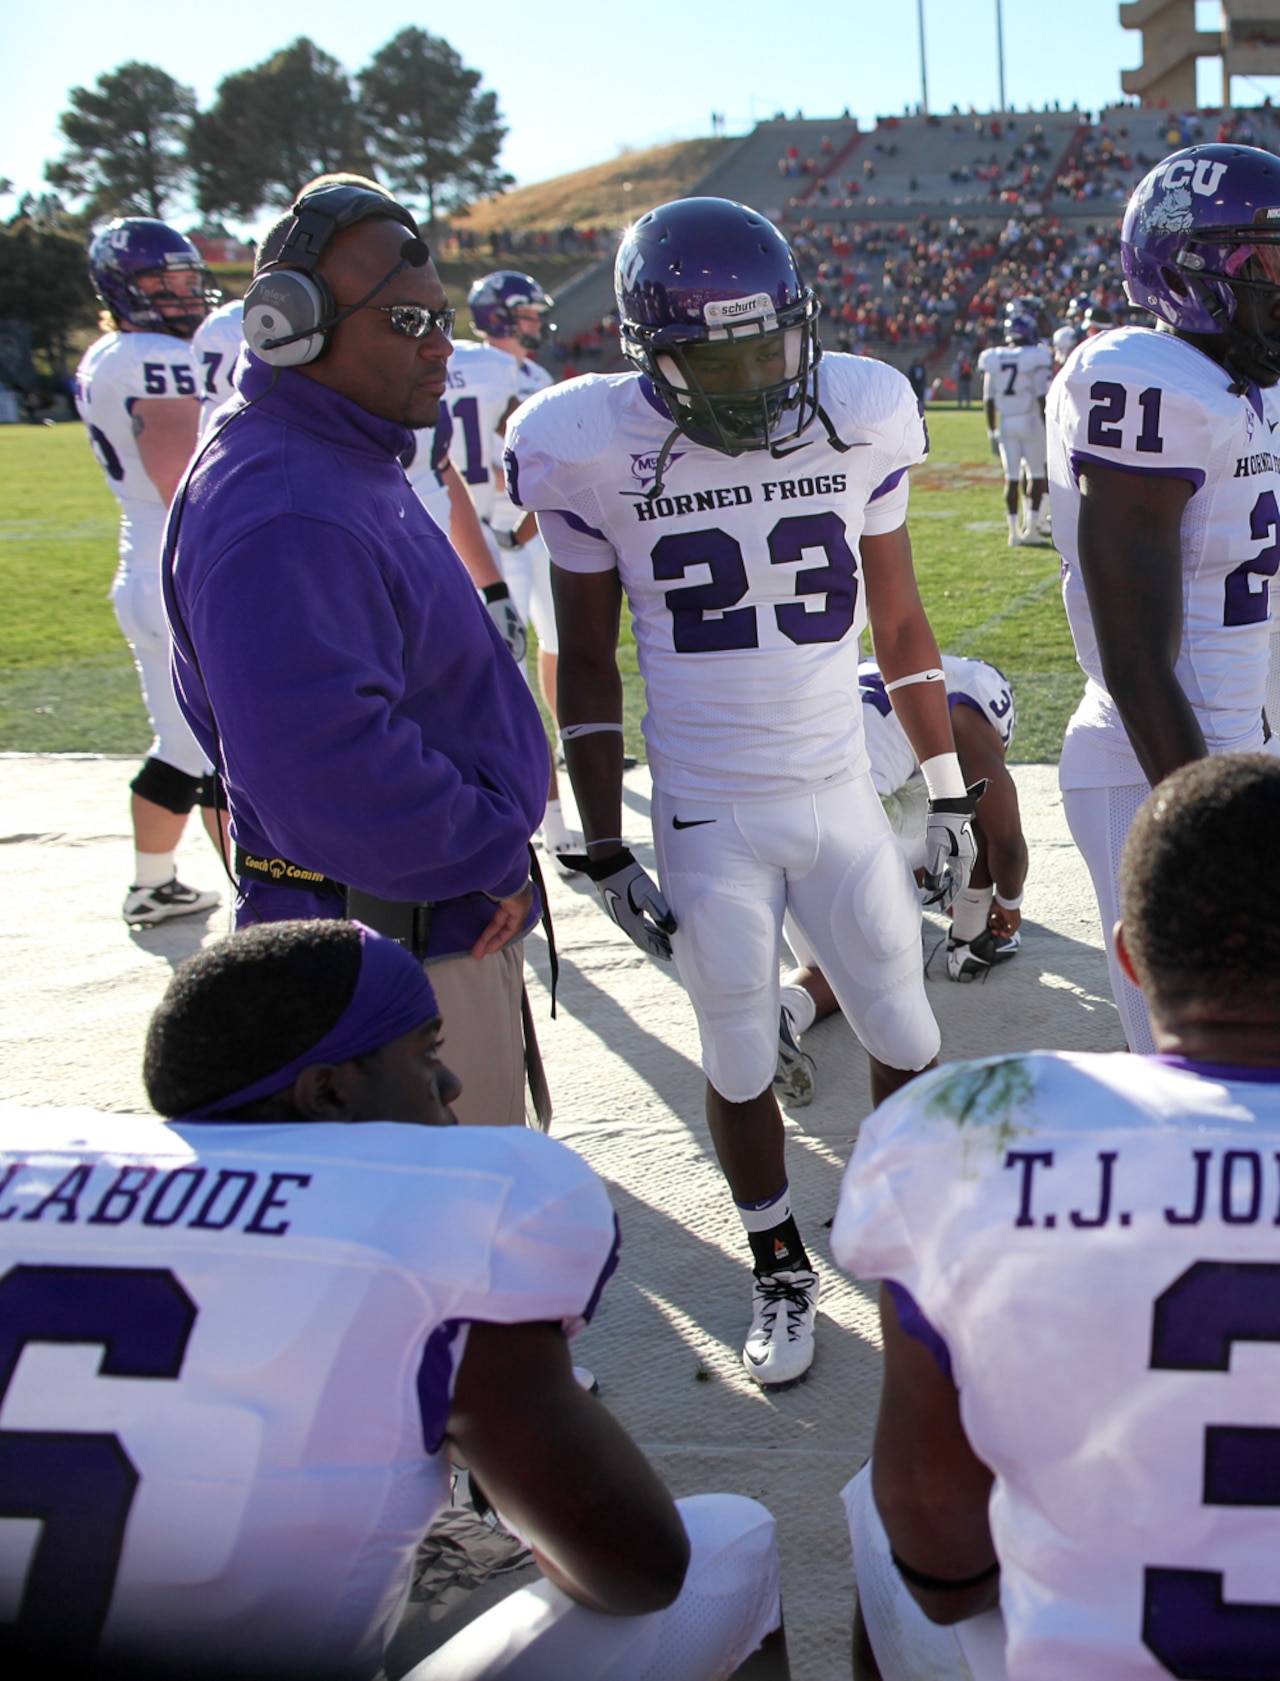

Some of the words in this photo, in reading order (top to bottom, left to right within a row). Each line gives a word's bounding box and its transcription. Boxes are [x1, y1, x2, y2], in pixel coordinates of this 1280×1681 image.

[1138, 159, 1228, 203] TCU
[721, 300, 757, 315] schutt
[142, 362, 198, 396] 55
[201, 351, 238, 394] 7
[1002, 362, 1018, 396] 7
[1088, 381, 1164, 453] 21
[633, 485, 752, 522] HORNED
[761, 474, 846, 502] FROGS
[650, 511, 858, 653] 23
[245, 855, 269, 872] Coach
[286, 865, 325, 882] Comm
[1005, 1151, 1131, 1229] T.J.
